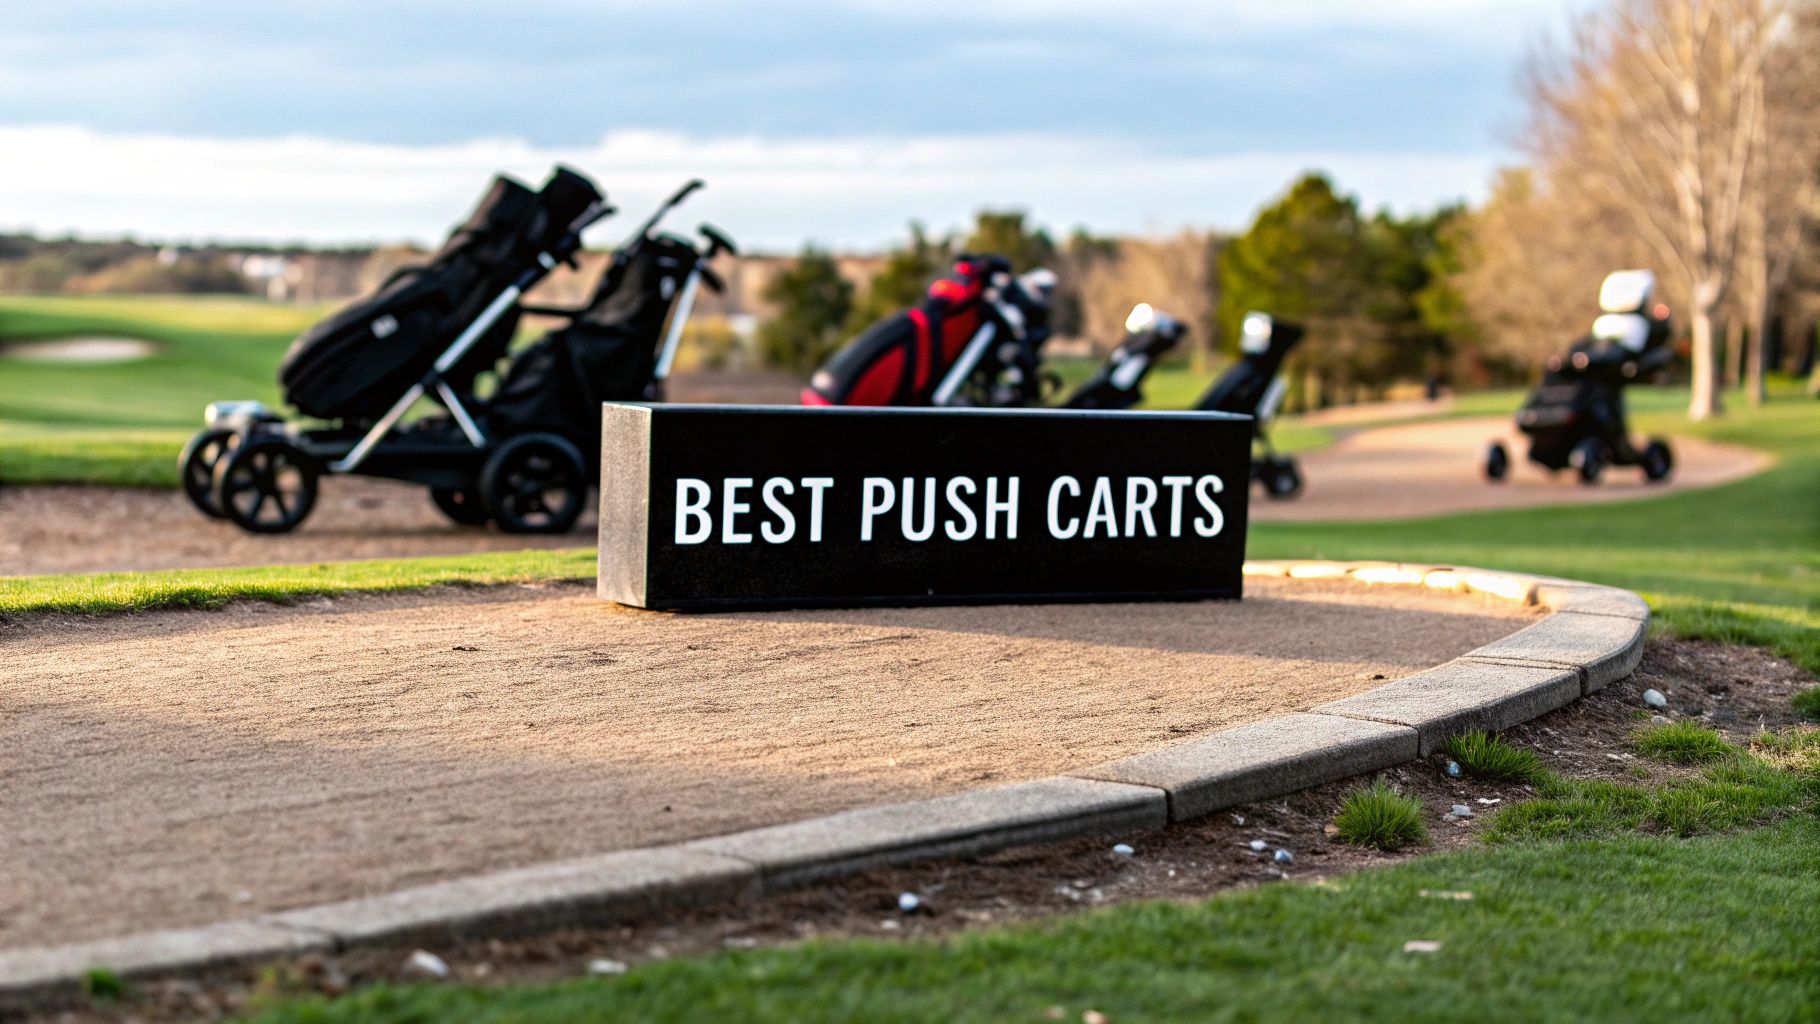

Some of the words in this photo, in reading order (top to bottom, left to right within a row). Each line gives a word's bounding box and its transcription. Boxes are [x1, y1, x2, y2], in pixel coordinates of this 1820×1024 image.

[674, 477, 834, 545] BEST
[860, 476, 1020, 544] PUSH
[1047, 474, 1224, 540] CARTS
